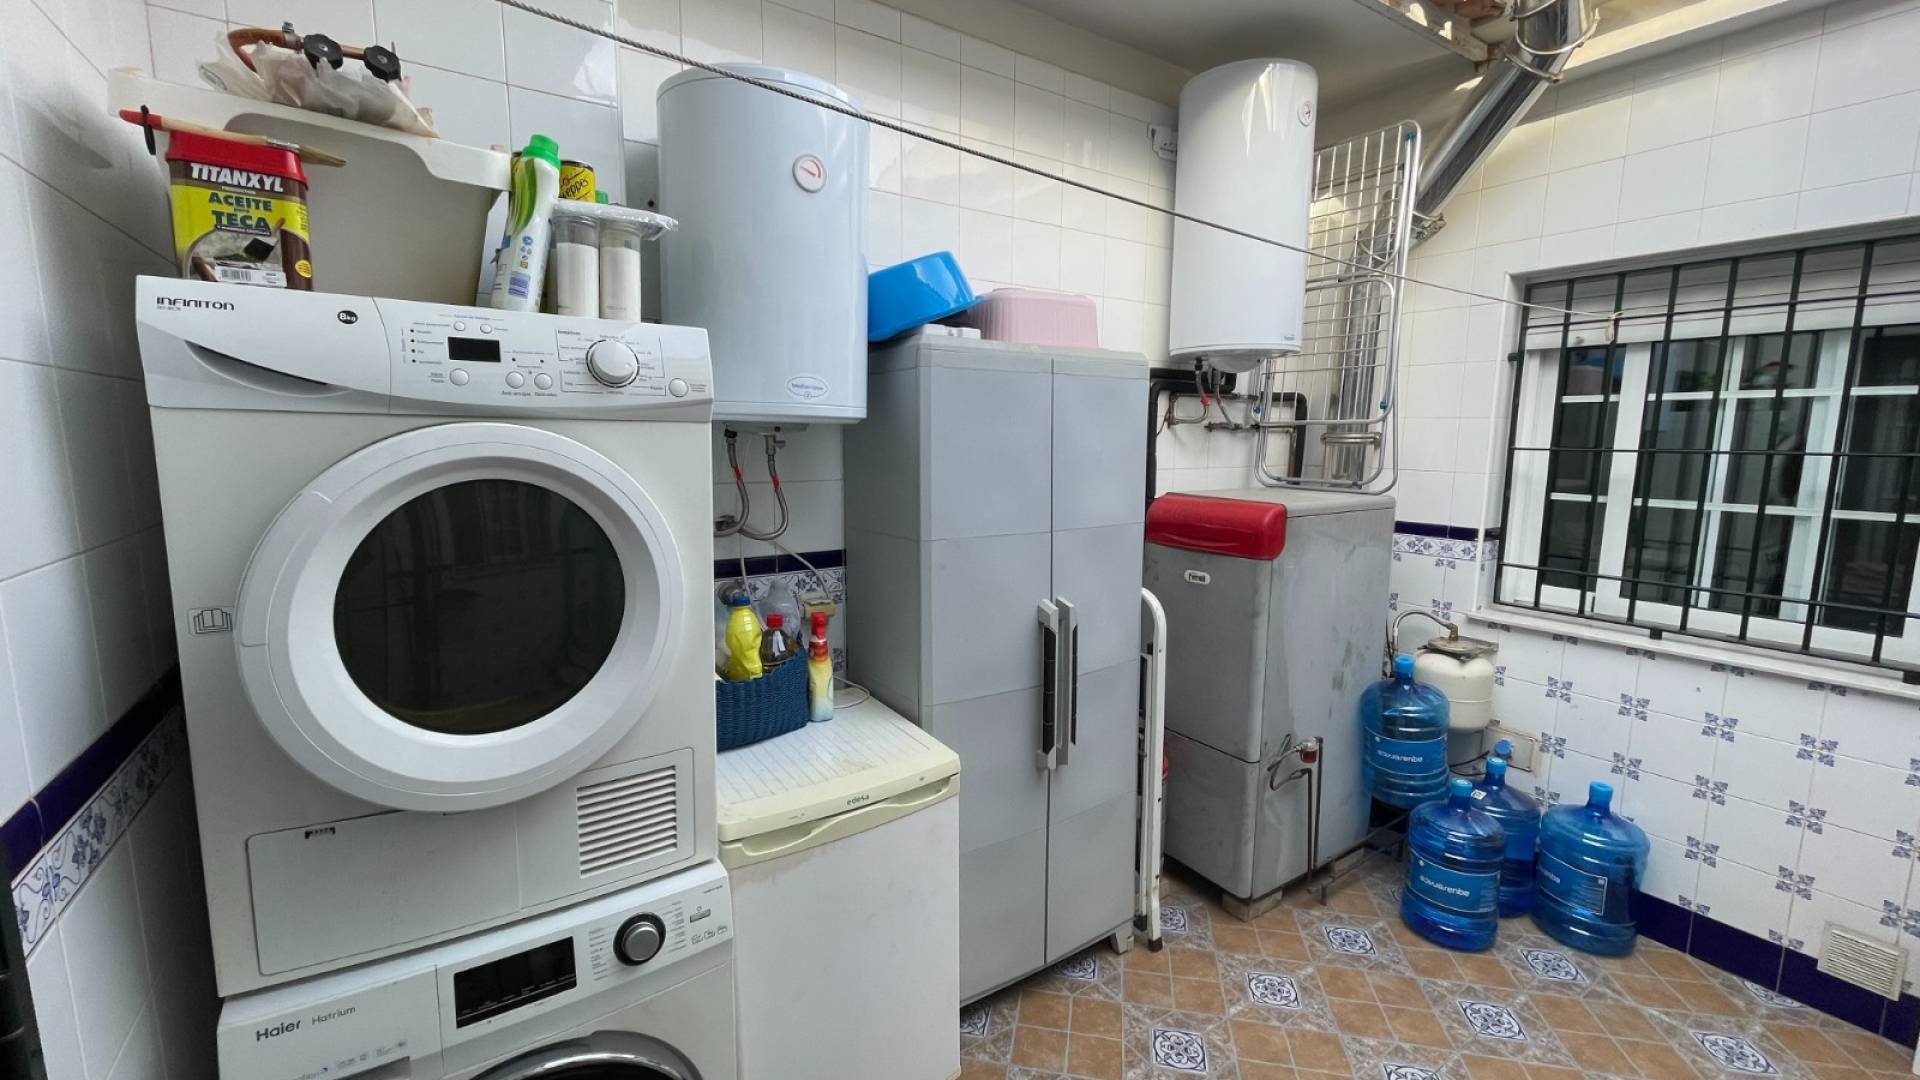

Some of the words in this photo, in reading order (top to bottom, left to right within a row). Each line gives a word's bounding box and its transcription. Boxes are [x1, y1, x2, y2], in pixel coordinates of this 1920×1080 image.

[190, 162, 284, 193] TITANXYL
[208, 191, 273, 212] ACEITE
[211, 209, 272, 231] TECA
[255, 1019, 302, 1042] Haier
[312, 1005, 356, 1026] Hatrium
